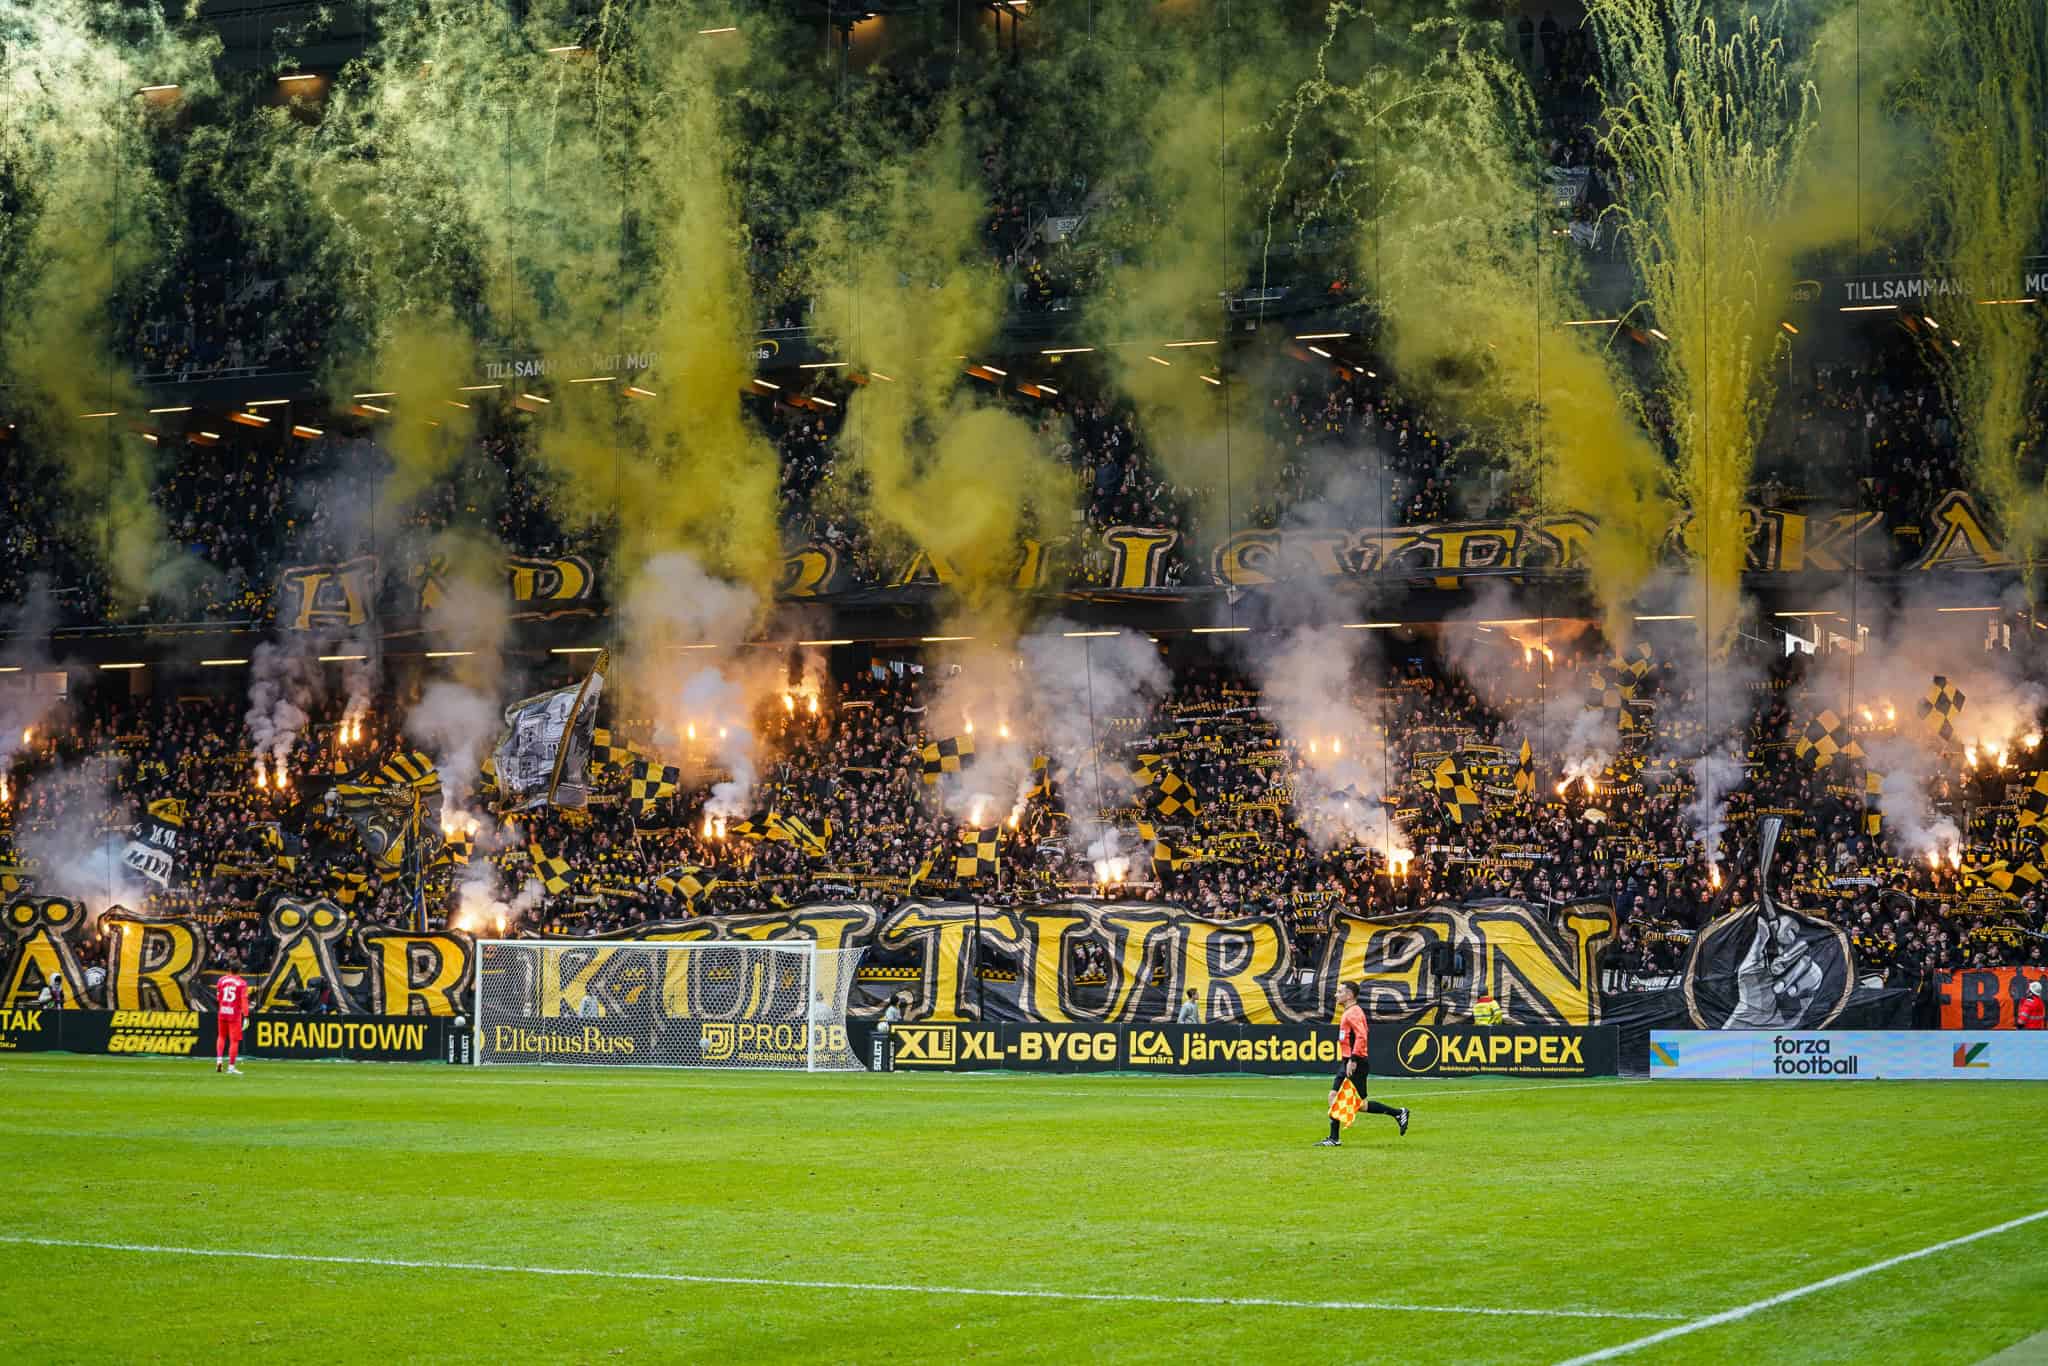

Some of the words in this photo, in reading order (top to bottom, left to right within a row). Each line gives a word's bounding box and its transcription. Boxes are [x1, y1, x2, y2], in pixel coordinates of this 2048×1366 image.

[1, 898, 205, 1010] ÄR
[528, 900, 1614, 1026] KULTUREN
[223, 986, 236, 1002] 15
[110, 1010, 199, 1028] BRUNNA
[107, 1034, 199, 1054] SCHAKT
[257, 1021, 424, 1050] BRANDTOWN
[960, 1031, 1117, 1062] XL-BYGG
[1129, 1031, 1173, 1056] ICA
[1774, 1036, 1830, 1054] forza
[1441, 1035, 1585, 1064] KAPPEX
[1774, 1056, 1858, 1075] football
